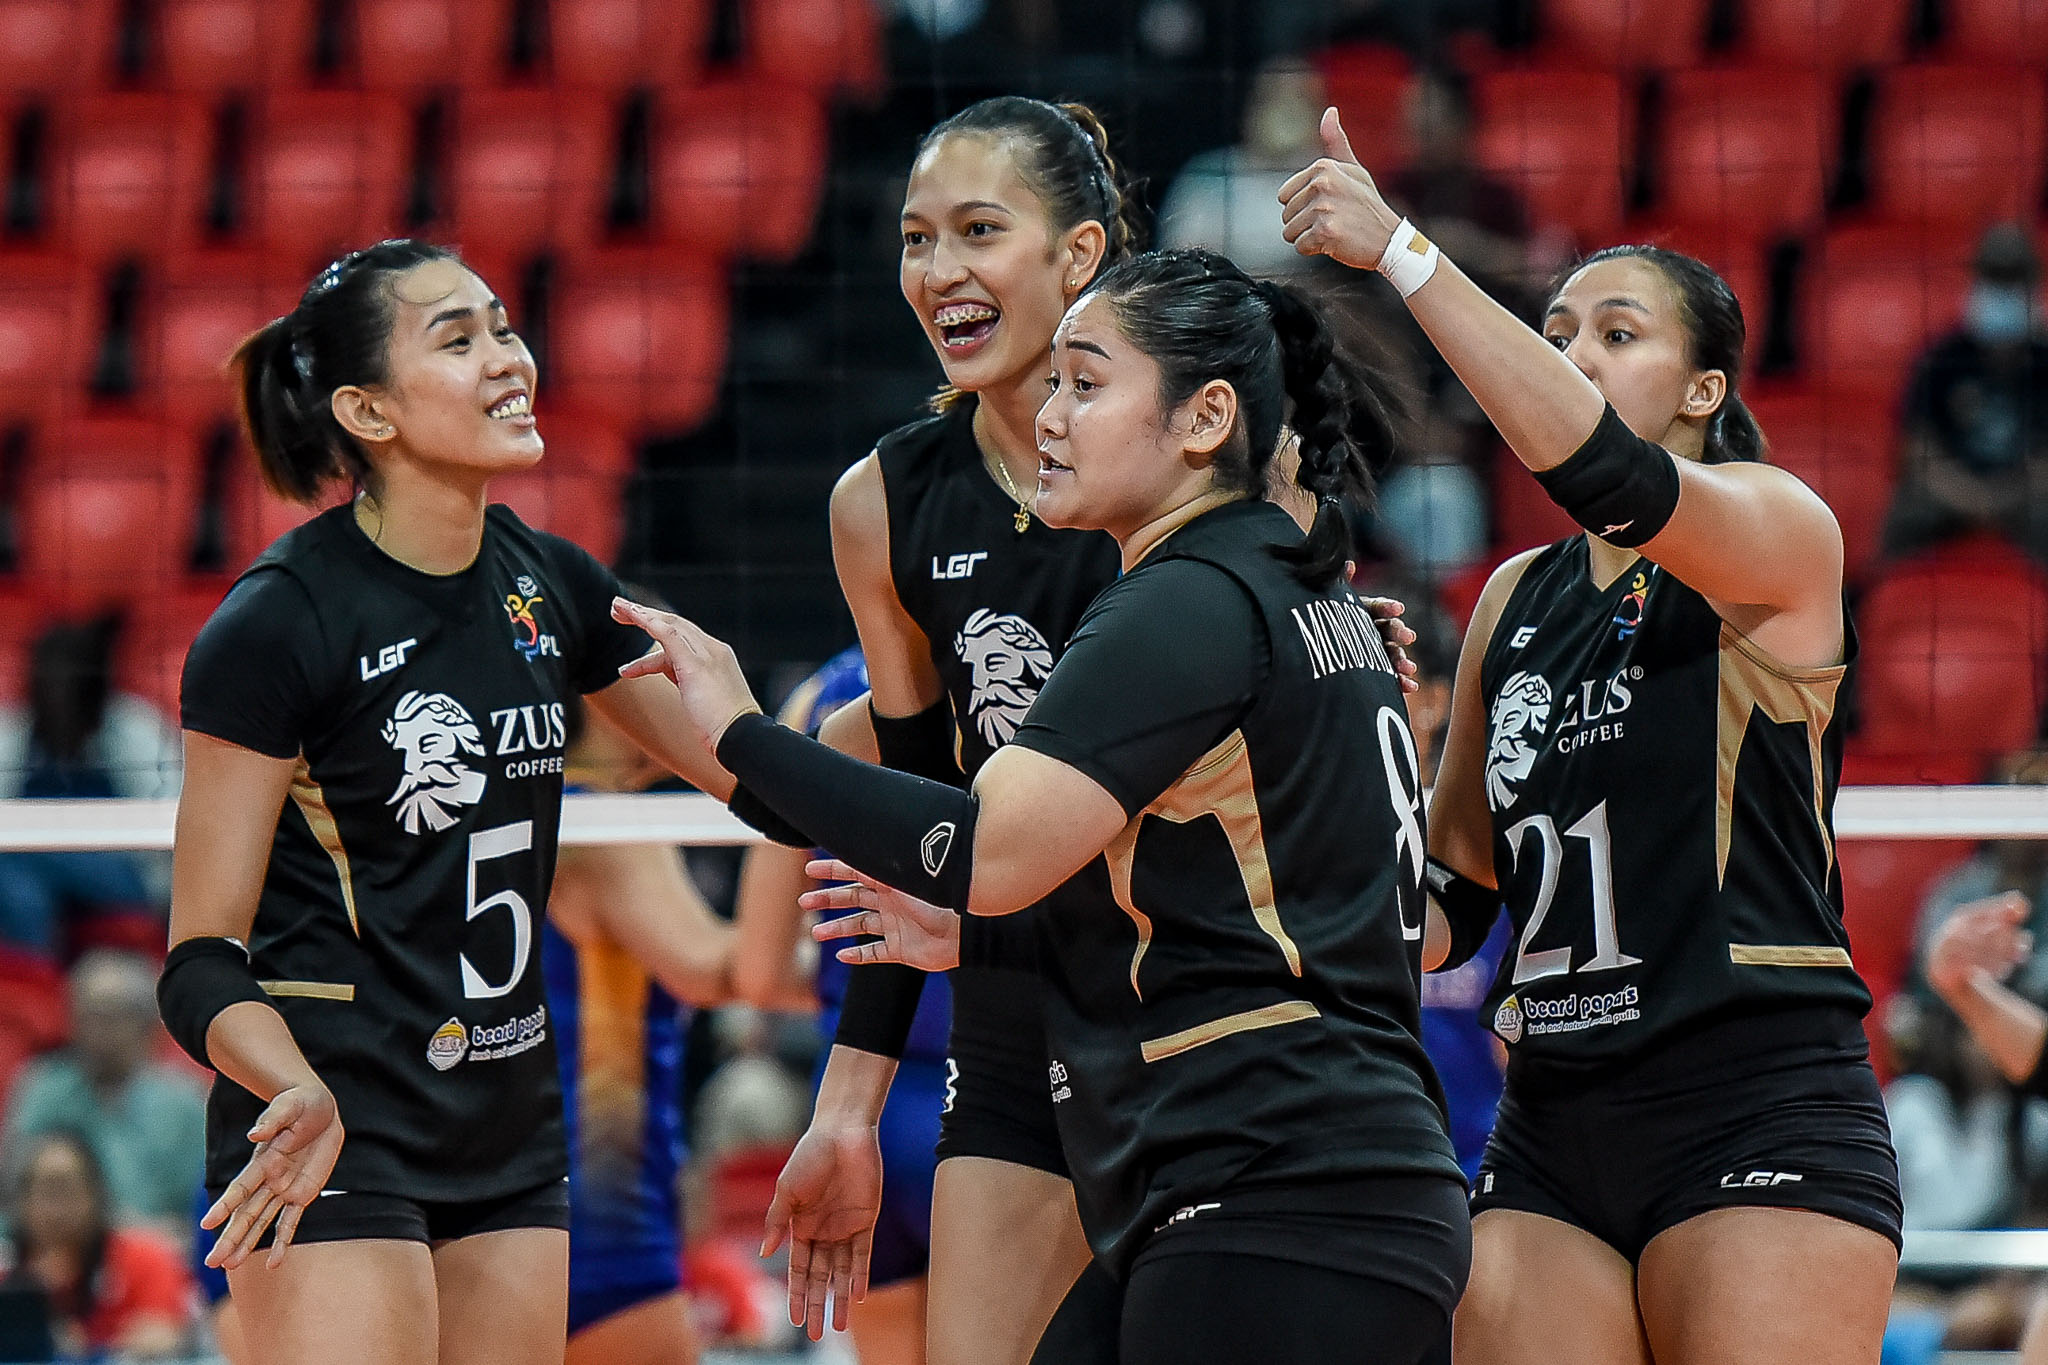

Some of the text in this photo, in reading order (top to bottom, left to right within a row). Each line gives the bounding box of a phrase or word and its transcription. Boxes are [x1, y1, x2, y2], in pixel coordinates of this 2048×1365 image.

[490, 702, 566, 756] ZUS
[1557, 722, 1624, 754] COFFEE
[505, 756, 564, 779] COFFEE
[1376, 705, 1424, 941] 8
[459, 820, 533, 999] 5
[1504, 798, 1643, 985] 21
[1524, 983, 1638, 1019] beard papa's
[1613, 1008, 1640, 1025] puffs
[472, 1017, 517, 1047] beard
